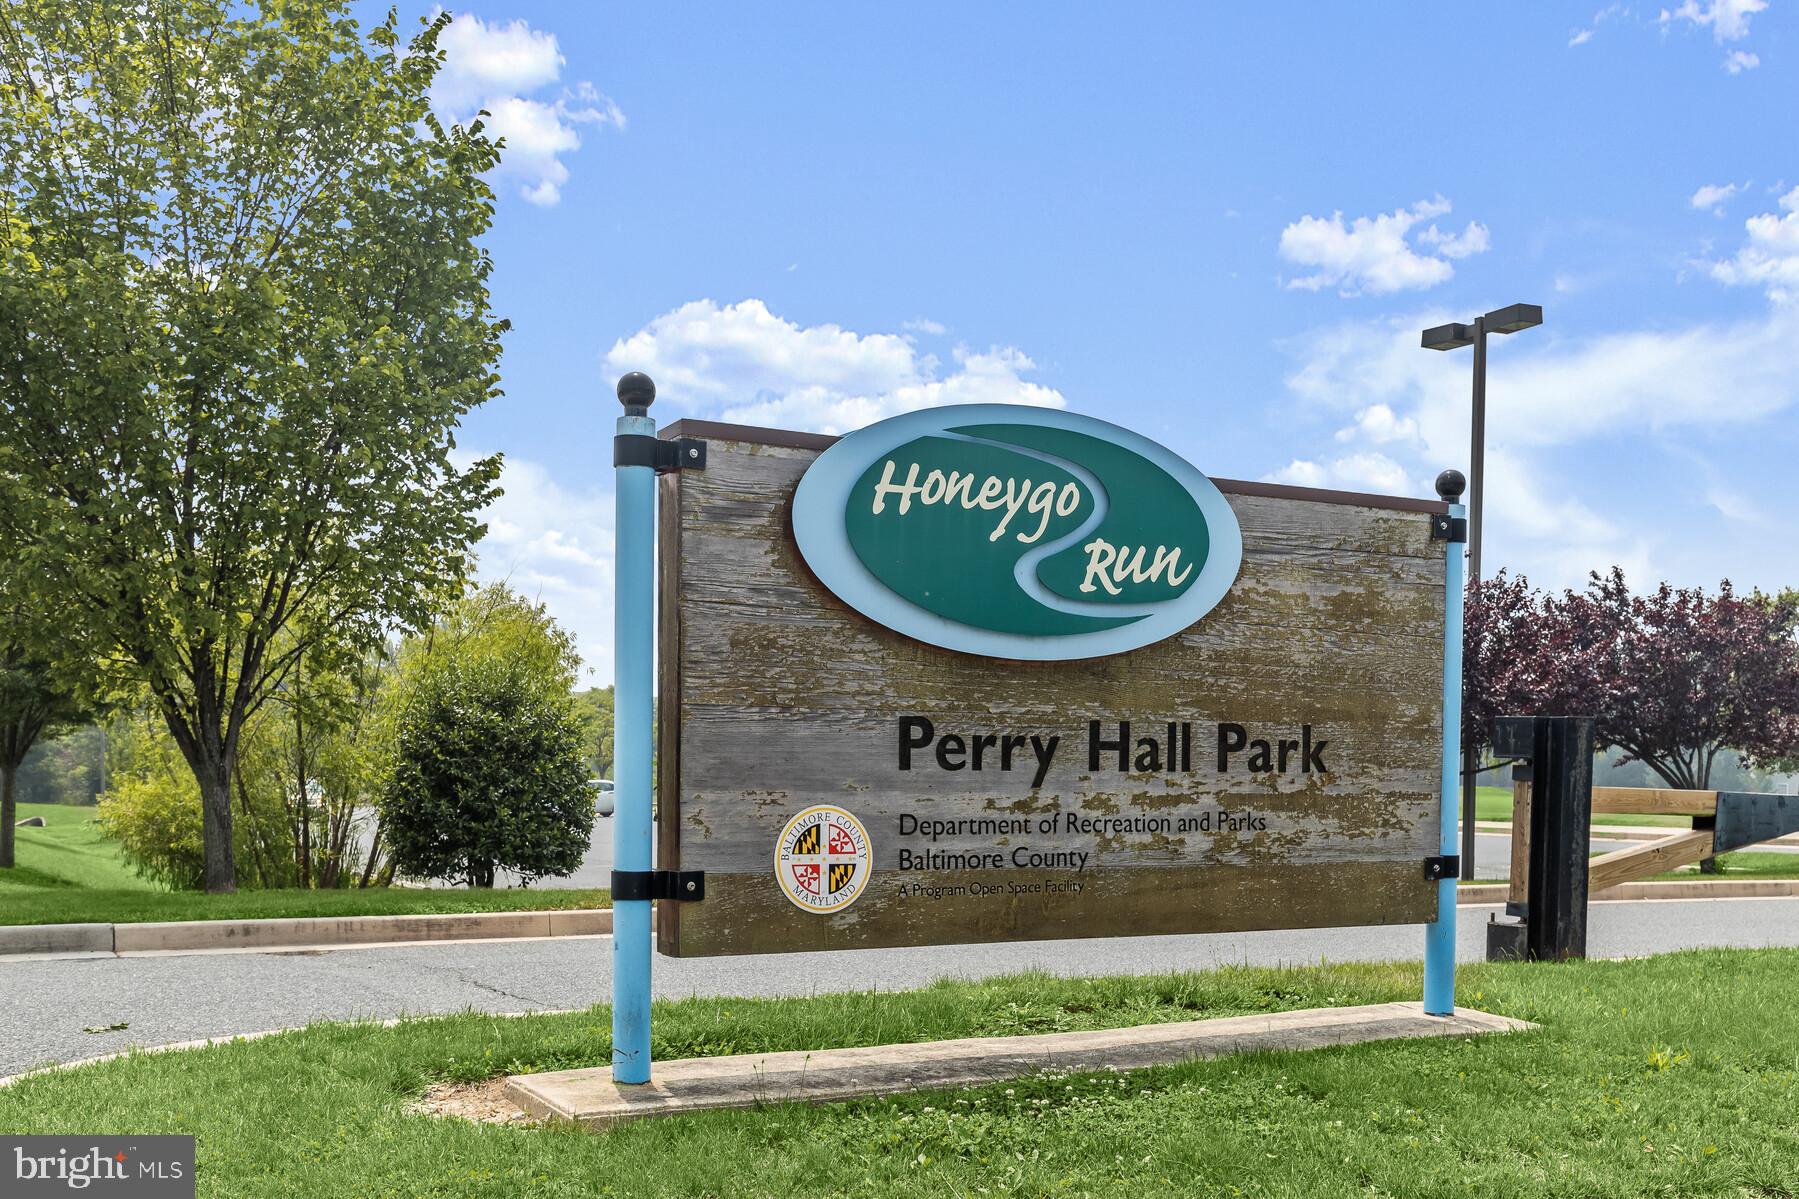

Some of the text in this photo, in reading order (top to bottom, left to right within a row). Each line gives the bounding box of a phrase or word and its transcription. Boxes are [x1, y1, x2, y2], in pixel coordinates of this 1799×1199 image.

[872, 460, 1080, 543] Honeygo
[1079, 538, 1193, 595] Run
[898, 715, 1328, 788] Perry Hall Park
[780, 812, 867, 861] BALTIMORE COUNTY
[899, 811, 1266, 842] Department of Recreation and Parks
[899, 846, 1088, 873] Baltimore County
[792, 884, 856, 906] MARYLAND
[897, 879, 1084, 899] A Program Open Space Facility
